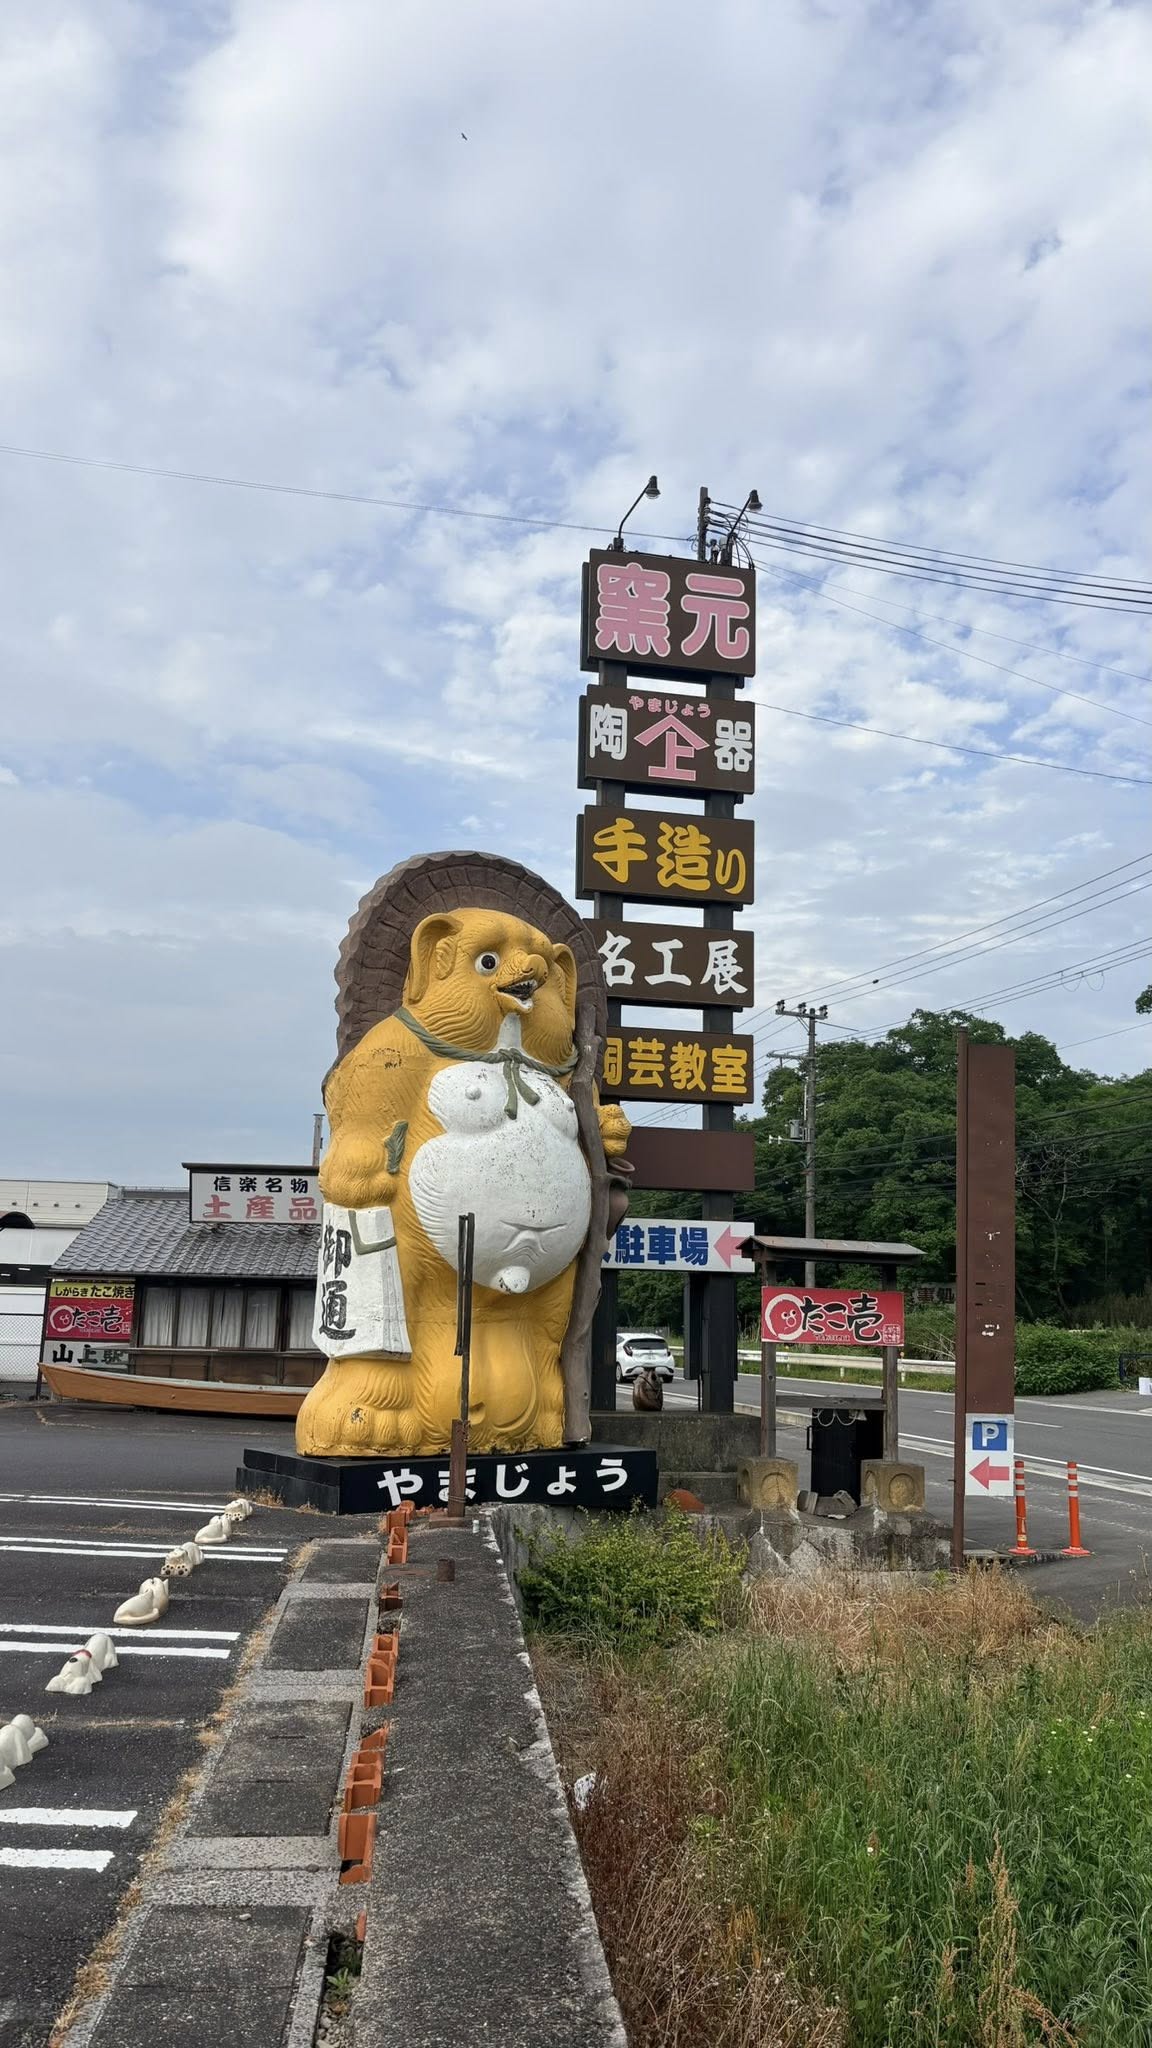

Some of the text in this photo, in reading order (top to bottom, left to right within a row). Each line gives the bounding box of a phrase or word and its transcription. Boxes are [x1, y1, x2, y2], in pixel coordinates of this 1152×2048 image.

[595, 562, 750, 659] 窯元
[629, 695, 711, 719] やまじょう
[592, 817, 746, 894] 手造り
[598, 930, 748, 995] 名工展
[213, 1175, 308, 1194] 信楽名物
[203, 1194, 317, 1221] 土産品
[602, 1225, 708, 1266] 駐車場
[981, 1422, 999, 1447] P
